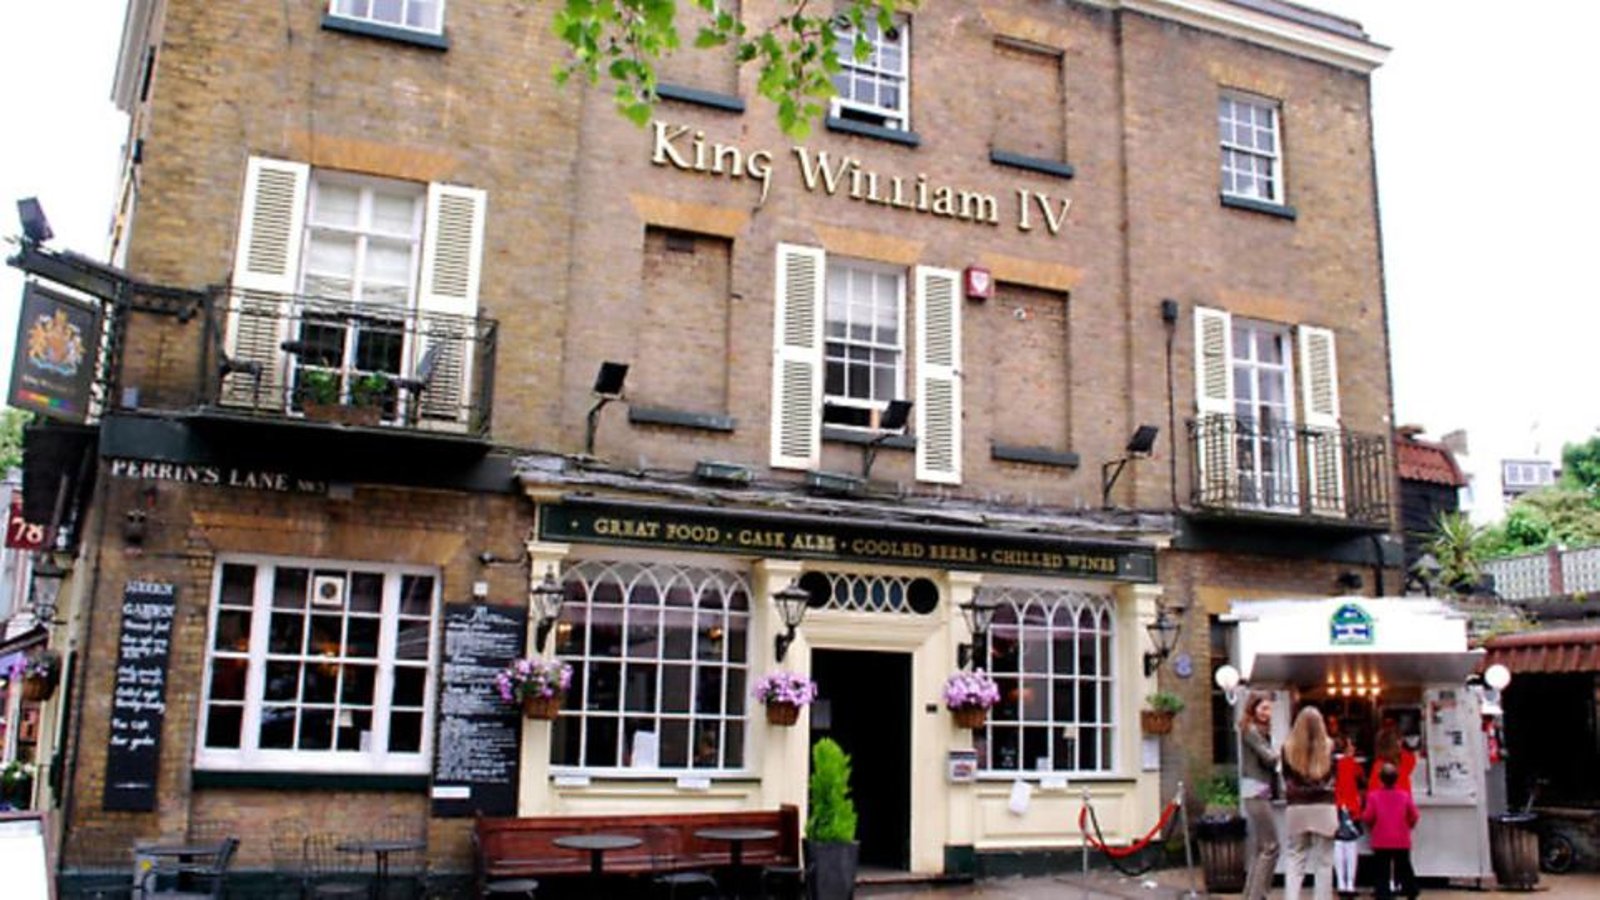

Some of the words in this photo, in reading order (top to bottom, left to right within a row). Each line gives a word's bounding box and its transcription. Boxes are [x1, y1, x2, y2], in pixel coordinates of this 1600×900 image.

[652, 119, 773, 203] King
[1015, 188, 1073, 235] IV
[111, 459, 220, 483] PERRIN'S
[229, 469, 289, 491] LANE
[593, 518, 662, 538] GREAT
[665, 523, 719, 542] FOOD
[738, 529, 787, 548] CASK
[791, 535, 837, 550] ALES
[851, 539, 925, 556] COOLED
[929, 545, 978, 562] BEERS
[991, 550, 1063, 568] CHILLED
[1066, 555, 1117, 573] WINES
